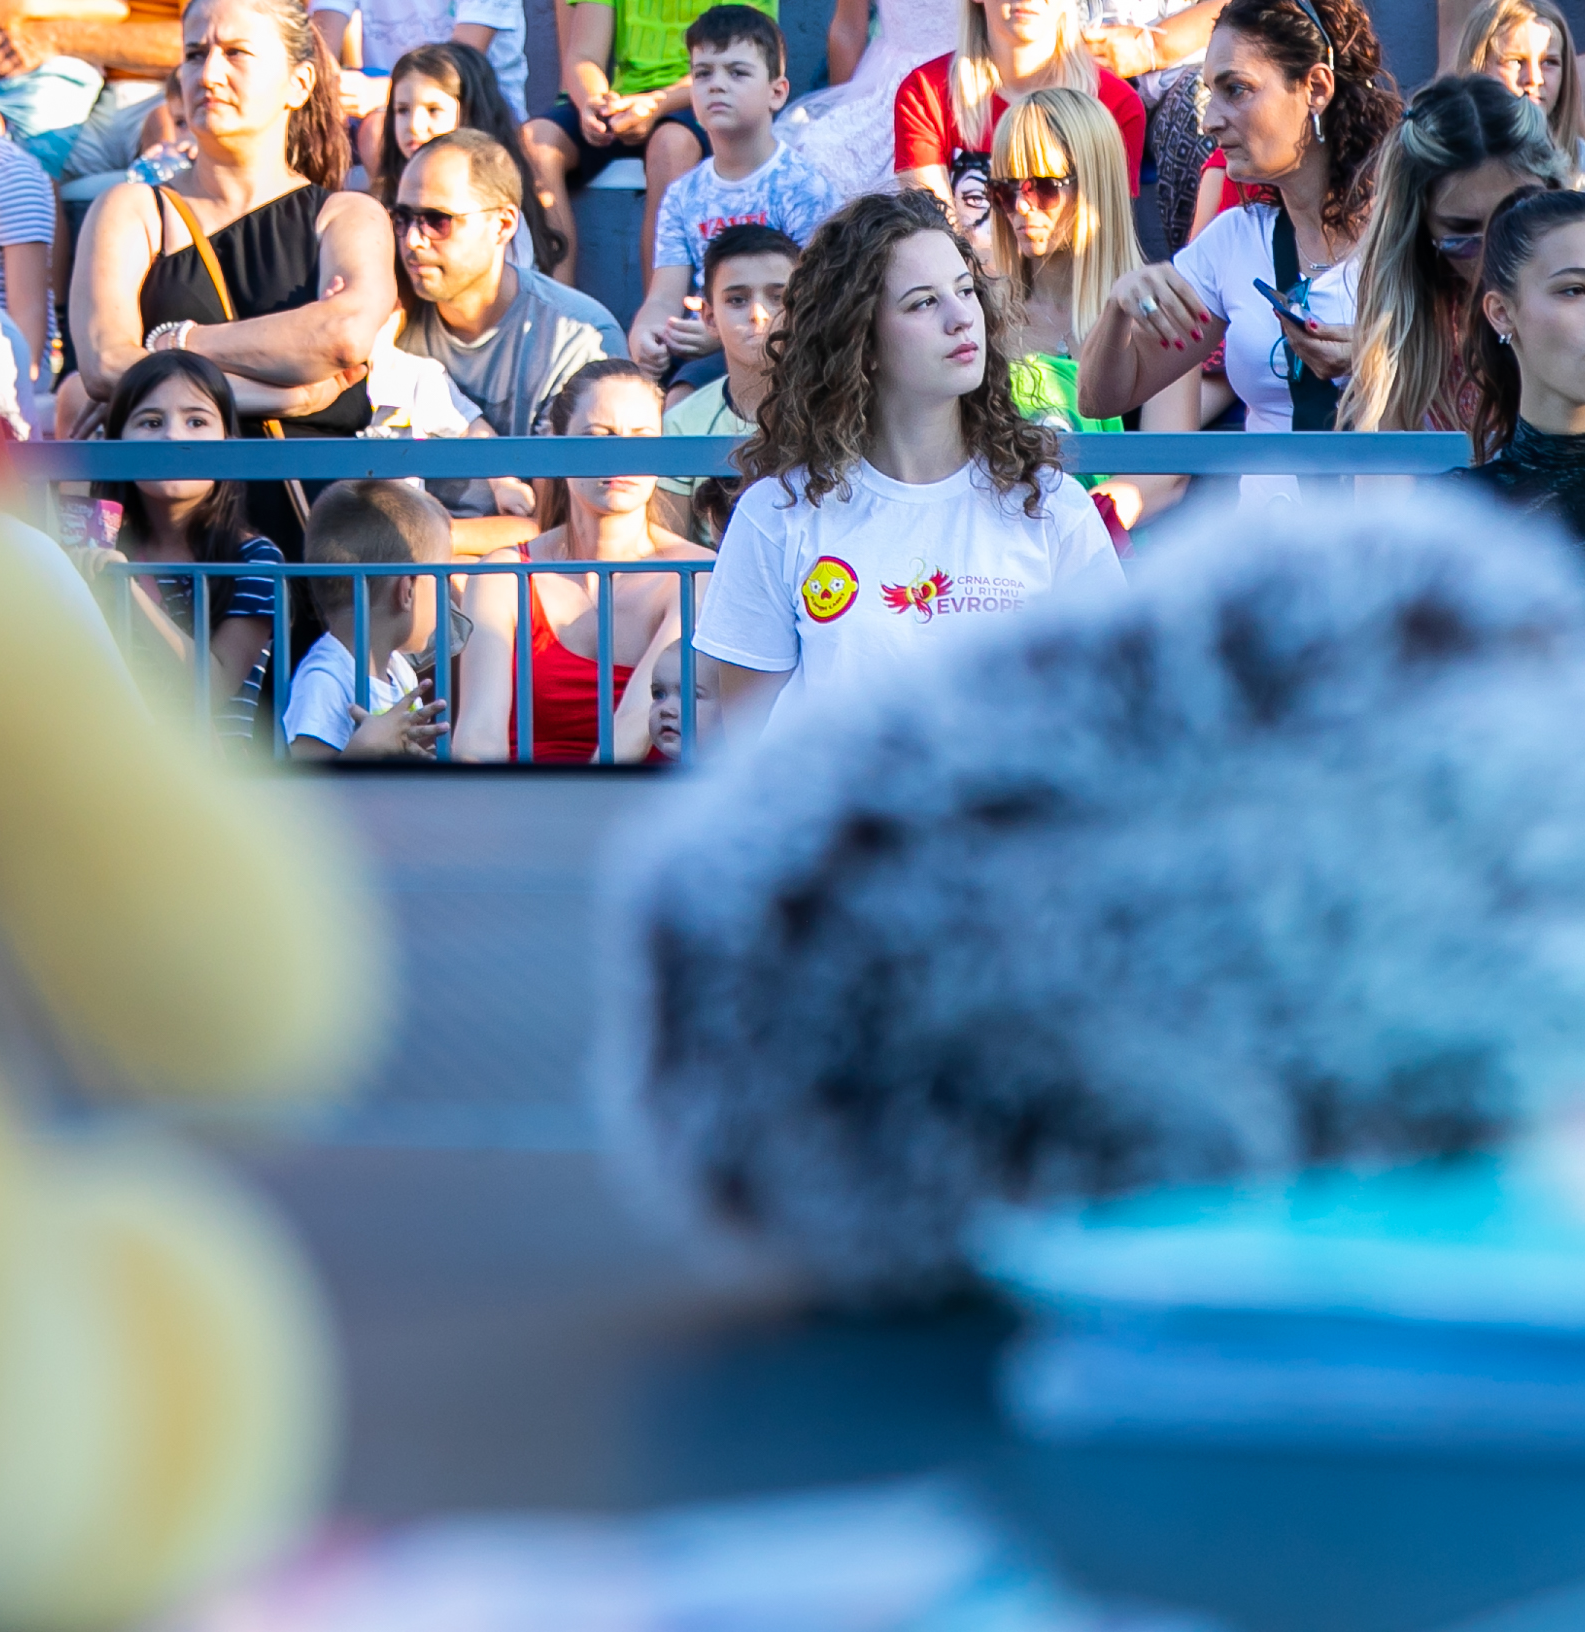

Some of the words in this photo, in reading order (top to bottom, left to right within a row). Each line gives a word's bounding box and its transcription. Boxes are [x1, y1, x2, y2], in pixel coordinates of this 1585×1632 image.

[957, 575, 990, 586] CRNA
[992, 577, 1026, 589] GORA
[964, 586, 974, 596] U
[978, 586, 1019, 598] RITMU
